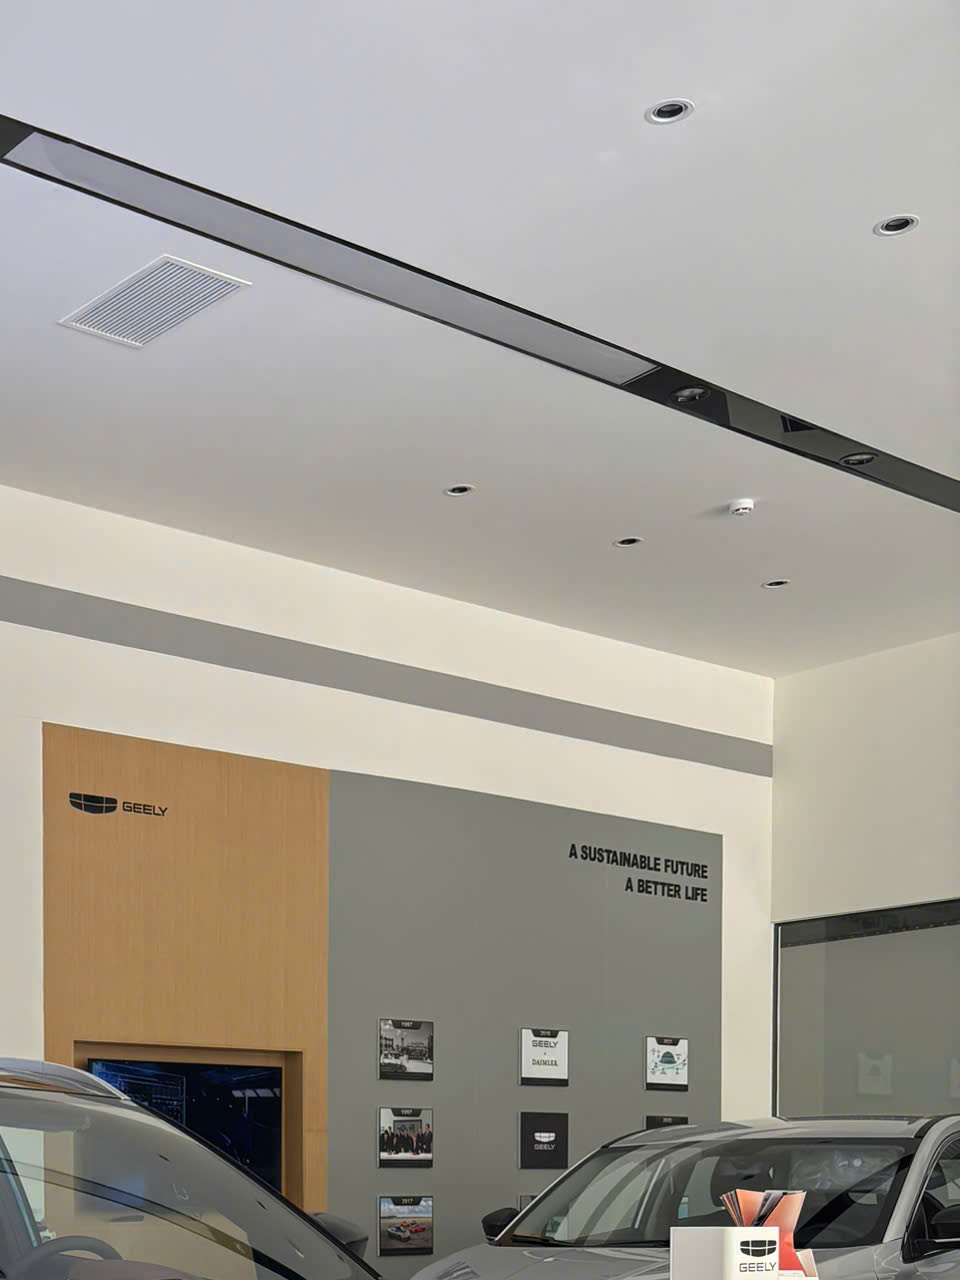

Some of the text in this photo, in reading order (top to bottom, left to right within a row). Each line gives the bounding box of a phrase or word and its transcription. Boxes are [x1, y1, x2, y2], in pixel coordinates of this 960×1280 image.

[122, 801, 168, 817] GEELY
[568, 843, 708, 879] A SUSTAINABLE FUTURE
[625, 877, 708, 902] A BETTER LIFE
[531, 1039, 559, 1048] GEELY
[533, 1143, 556, 1151] GEELY
[739, 1261, 777, 1273] GEELY
